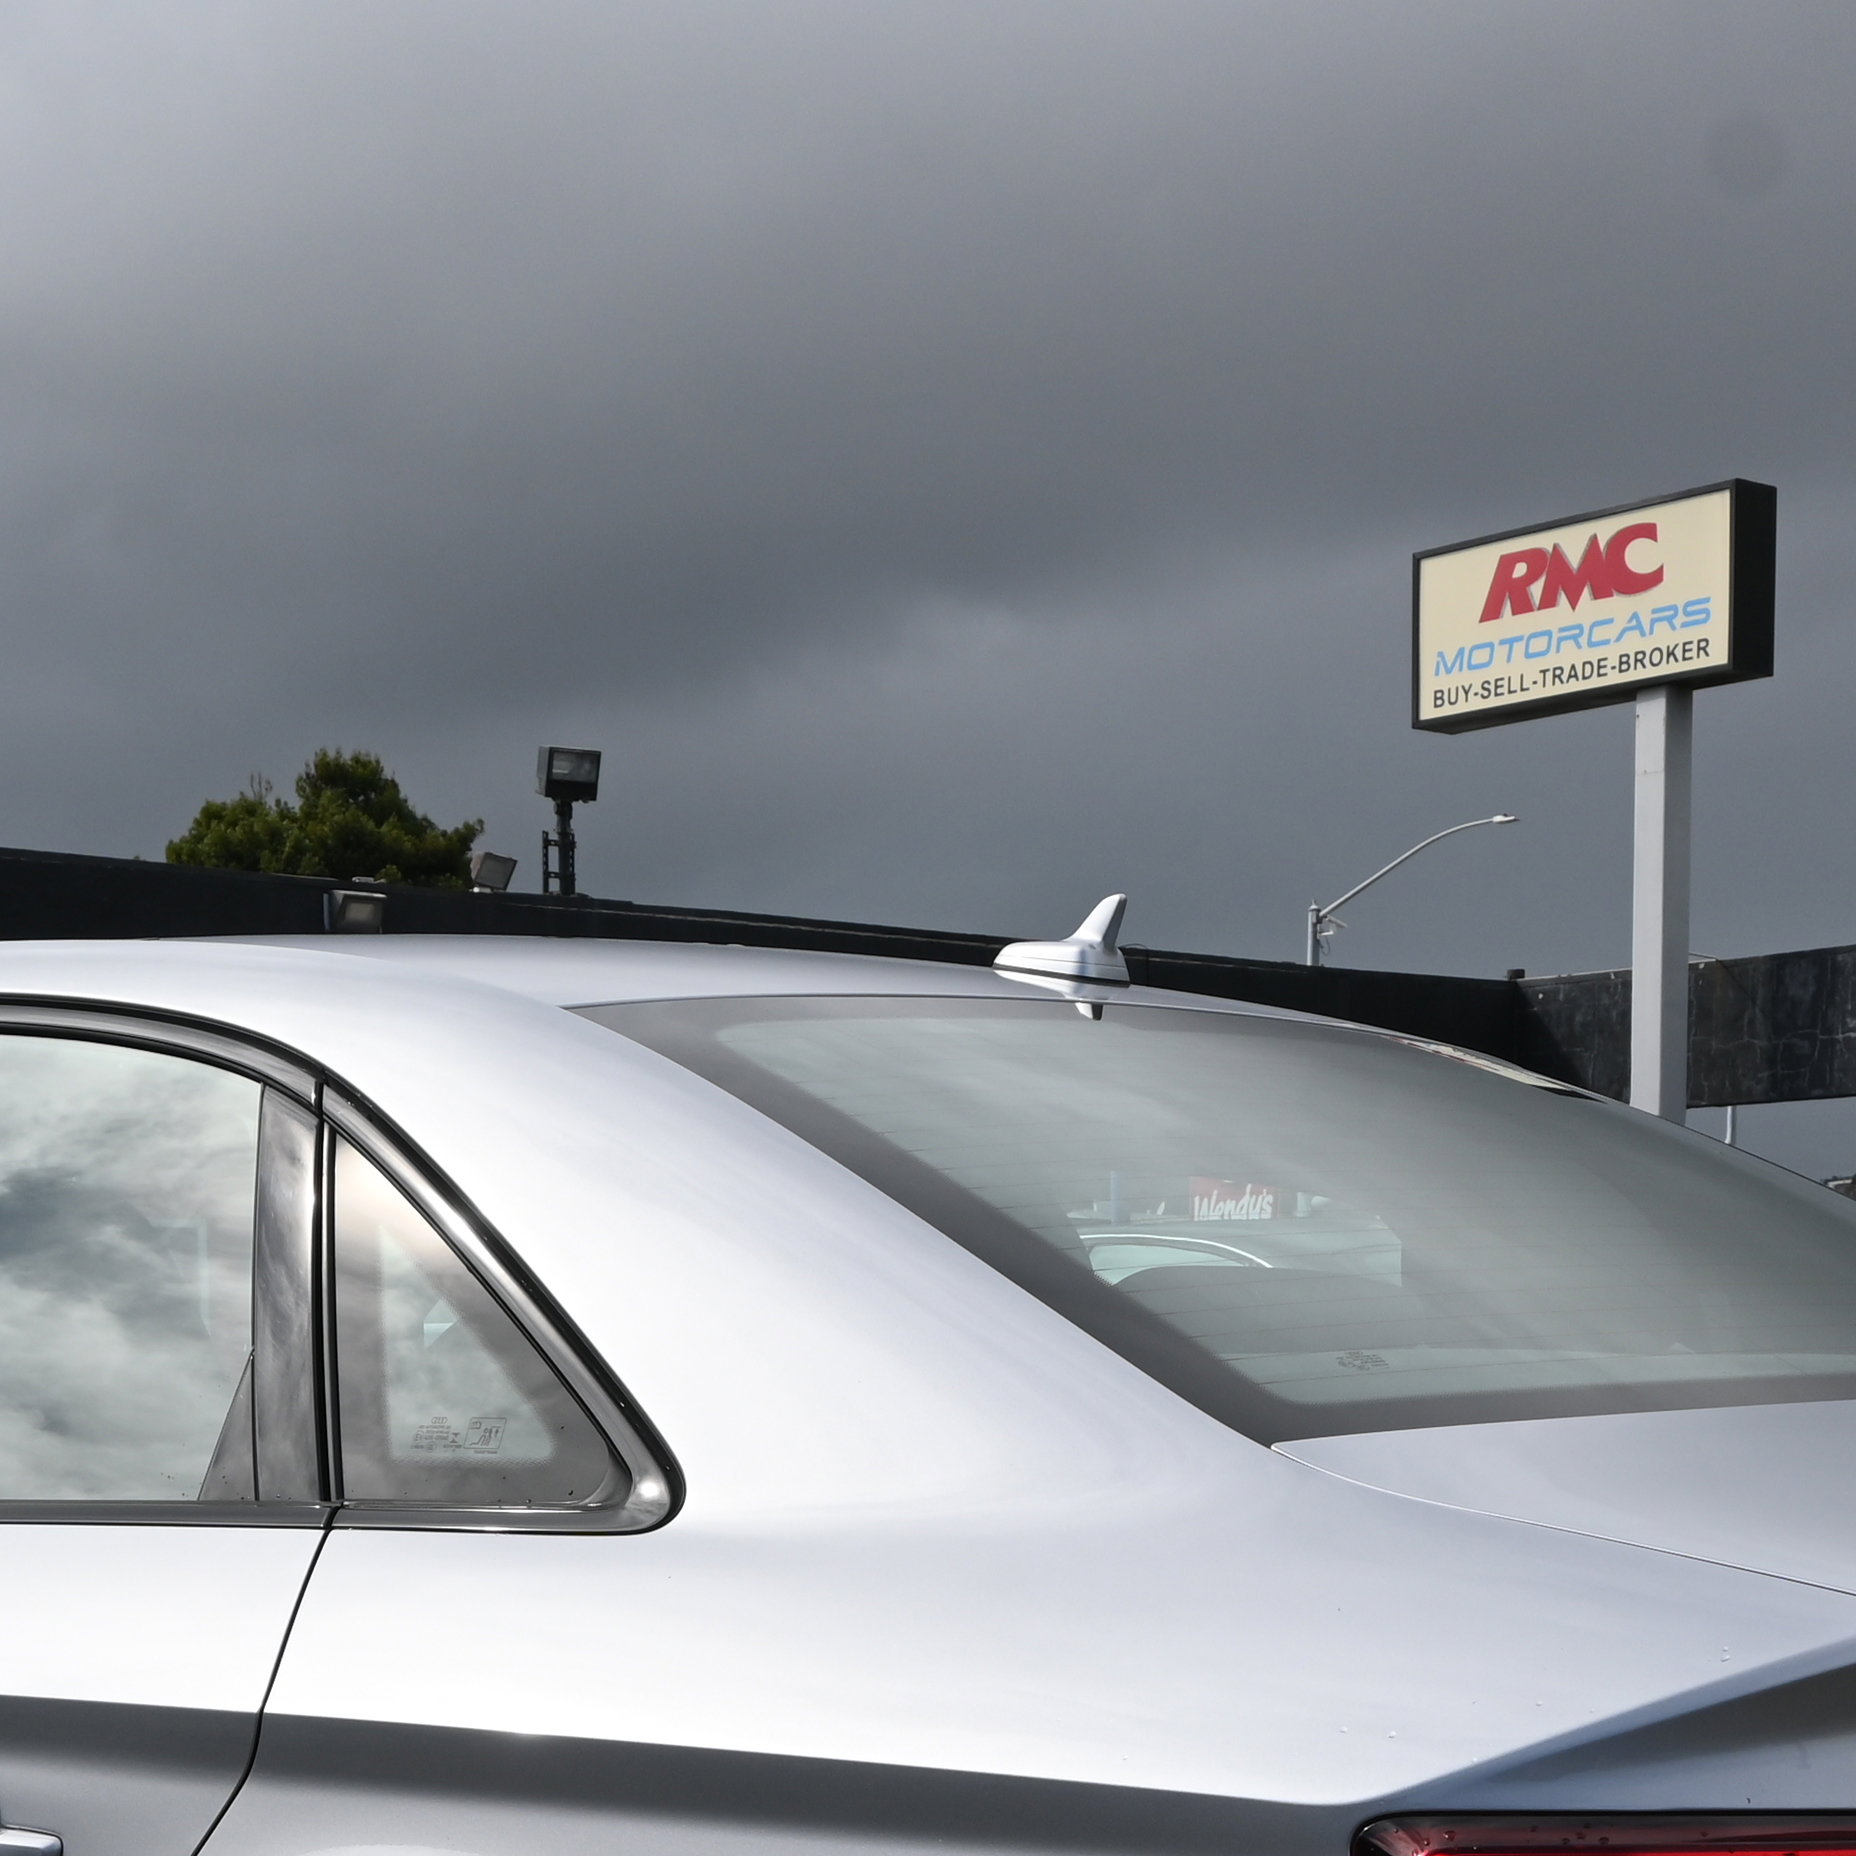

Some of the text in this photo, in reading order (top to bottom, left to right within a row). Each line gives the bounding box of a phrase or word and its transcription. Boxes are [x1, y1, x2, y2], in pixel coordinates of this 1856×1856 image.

[1479, 522, 1664, 623] RMC
[1433, 638, 1710, 709] BUY-SELL-TRADE-BROKER
[1434, 597, 1711, 677] MOTORCARS
